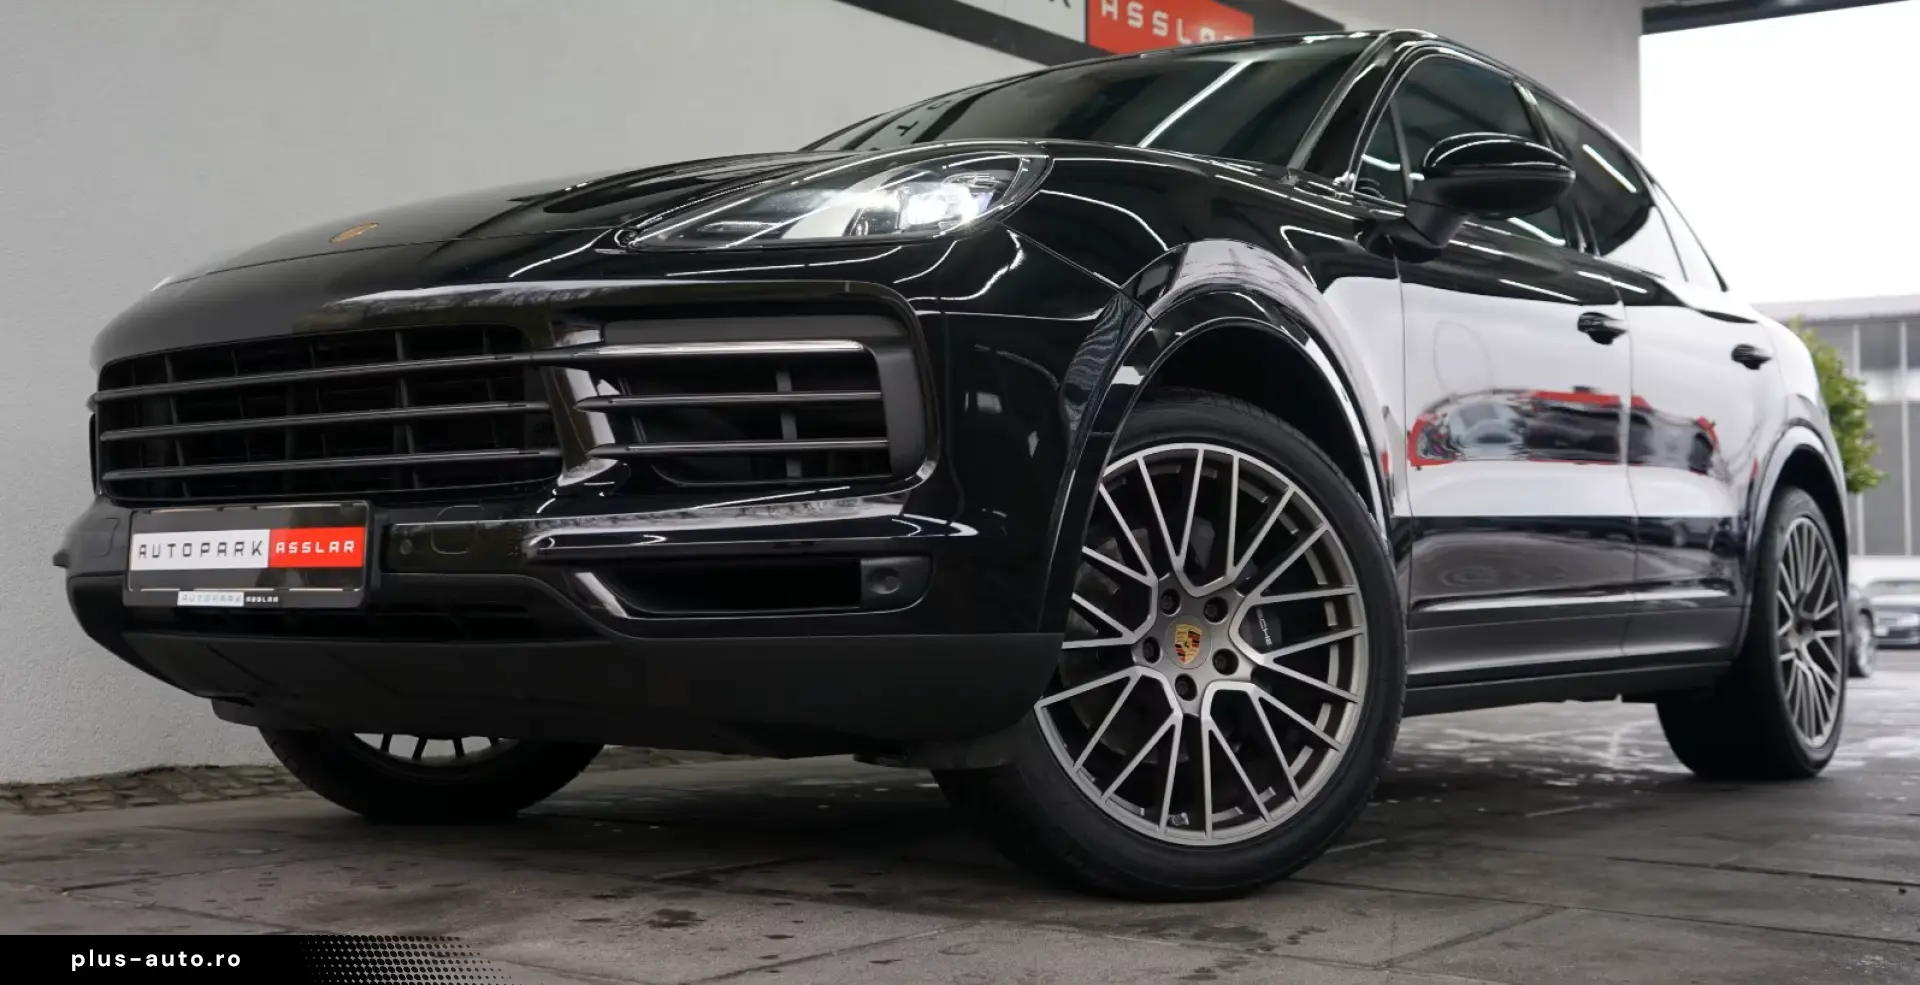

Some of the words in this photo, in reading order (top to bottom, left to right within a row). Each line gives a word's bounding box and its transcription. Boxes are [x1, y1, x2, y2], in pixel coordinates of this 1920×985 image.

[1101, 0, 1236, 45] ASSLA
[138, 540, 263, 558] AUTOPARK
[275, 540, 355, 554] ASSLAR
